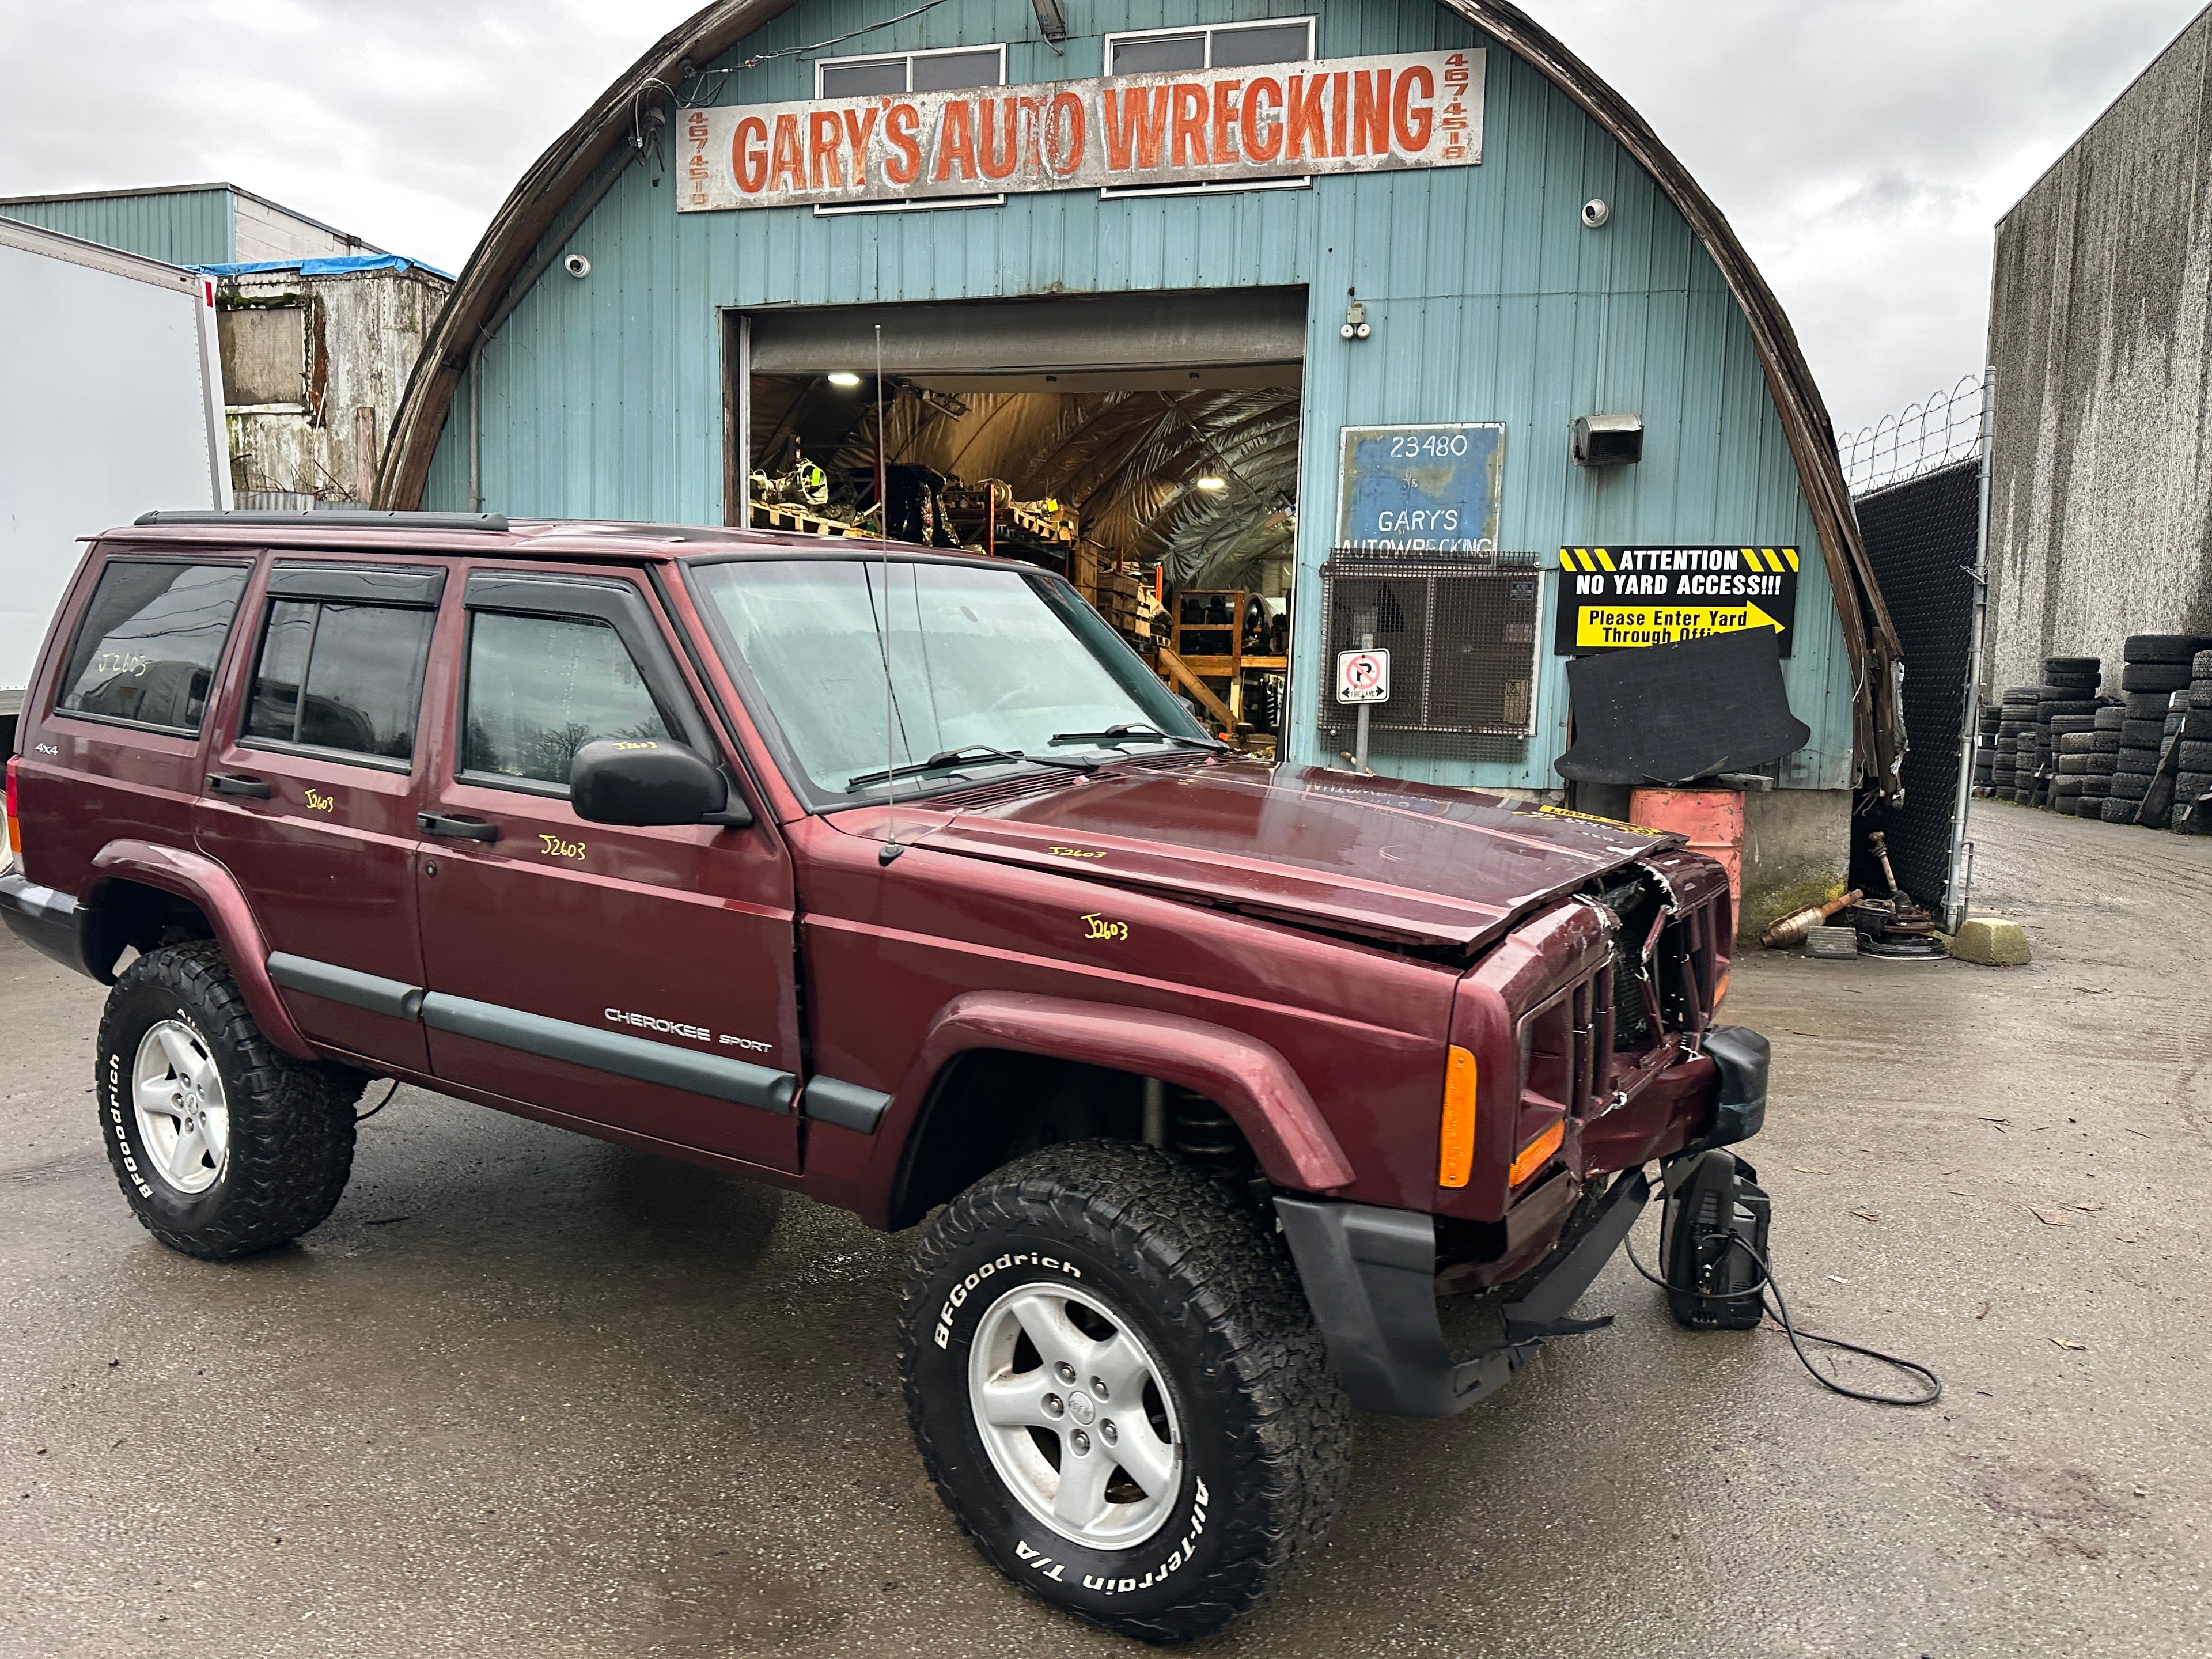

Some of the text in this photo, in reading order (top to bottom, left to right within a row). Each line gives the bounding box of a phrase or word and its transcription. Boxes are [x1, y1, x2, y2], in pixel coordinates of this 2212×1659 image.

[732, 65, 1434, 193] GARY'S AUTO WRECKING
[1390, 435, 1468, 458] 23480
[1378, 510, 1458, 531] GARY'S
[1619, 550, 1738, 570] ATTENTION
[1576, 575, 1781, 596] NO YARD ACCESS!!!
[1589, 610, 1747, 626] Please Enter Yard
[1603, 627, 1671, 645] Through
[612, 741, 657, 750] J2603
[305, 789, 334, 813] J2603
[539, 834, 586, 861] J2603
[1047, 846, 1107, 858] J2603
[1080, 912, 1128, 941] J2603
[604, 1007, 773, 1053] CHEROKEE SPORT
[108, 1054, 153, 1199] BFGoodrich
[934, 1252, 1082, 1350] BFGoodrich
[1014, 1476, 1209, 1596] All-Terrain T/A
